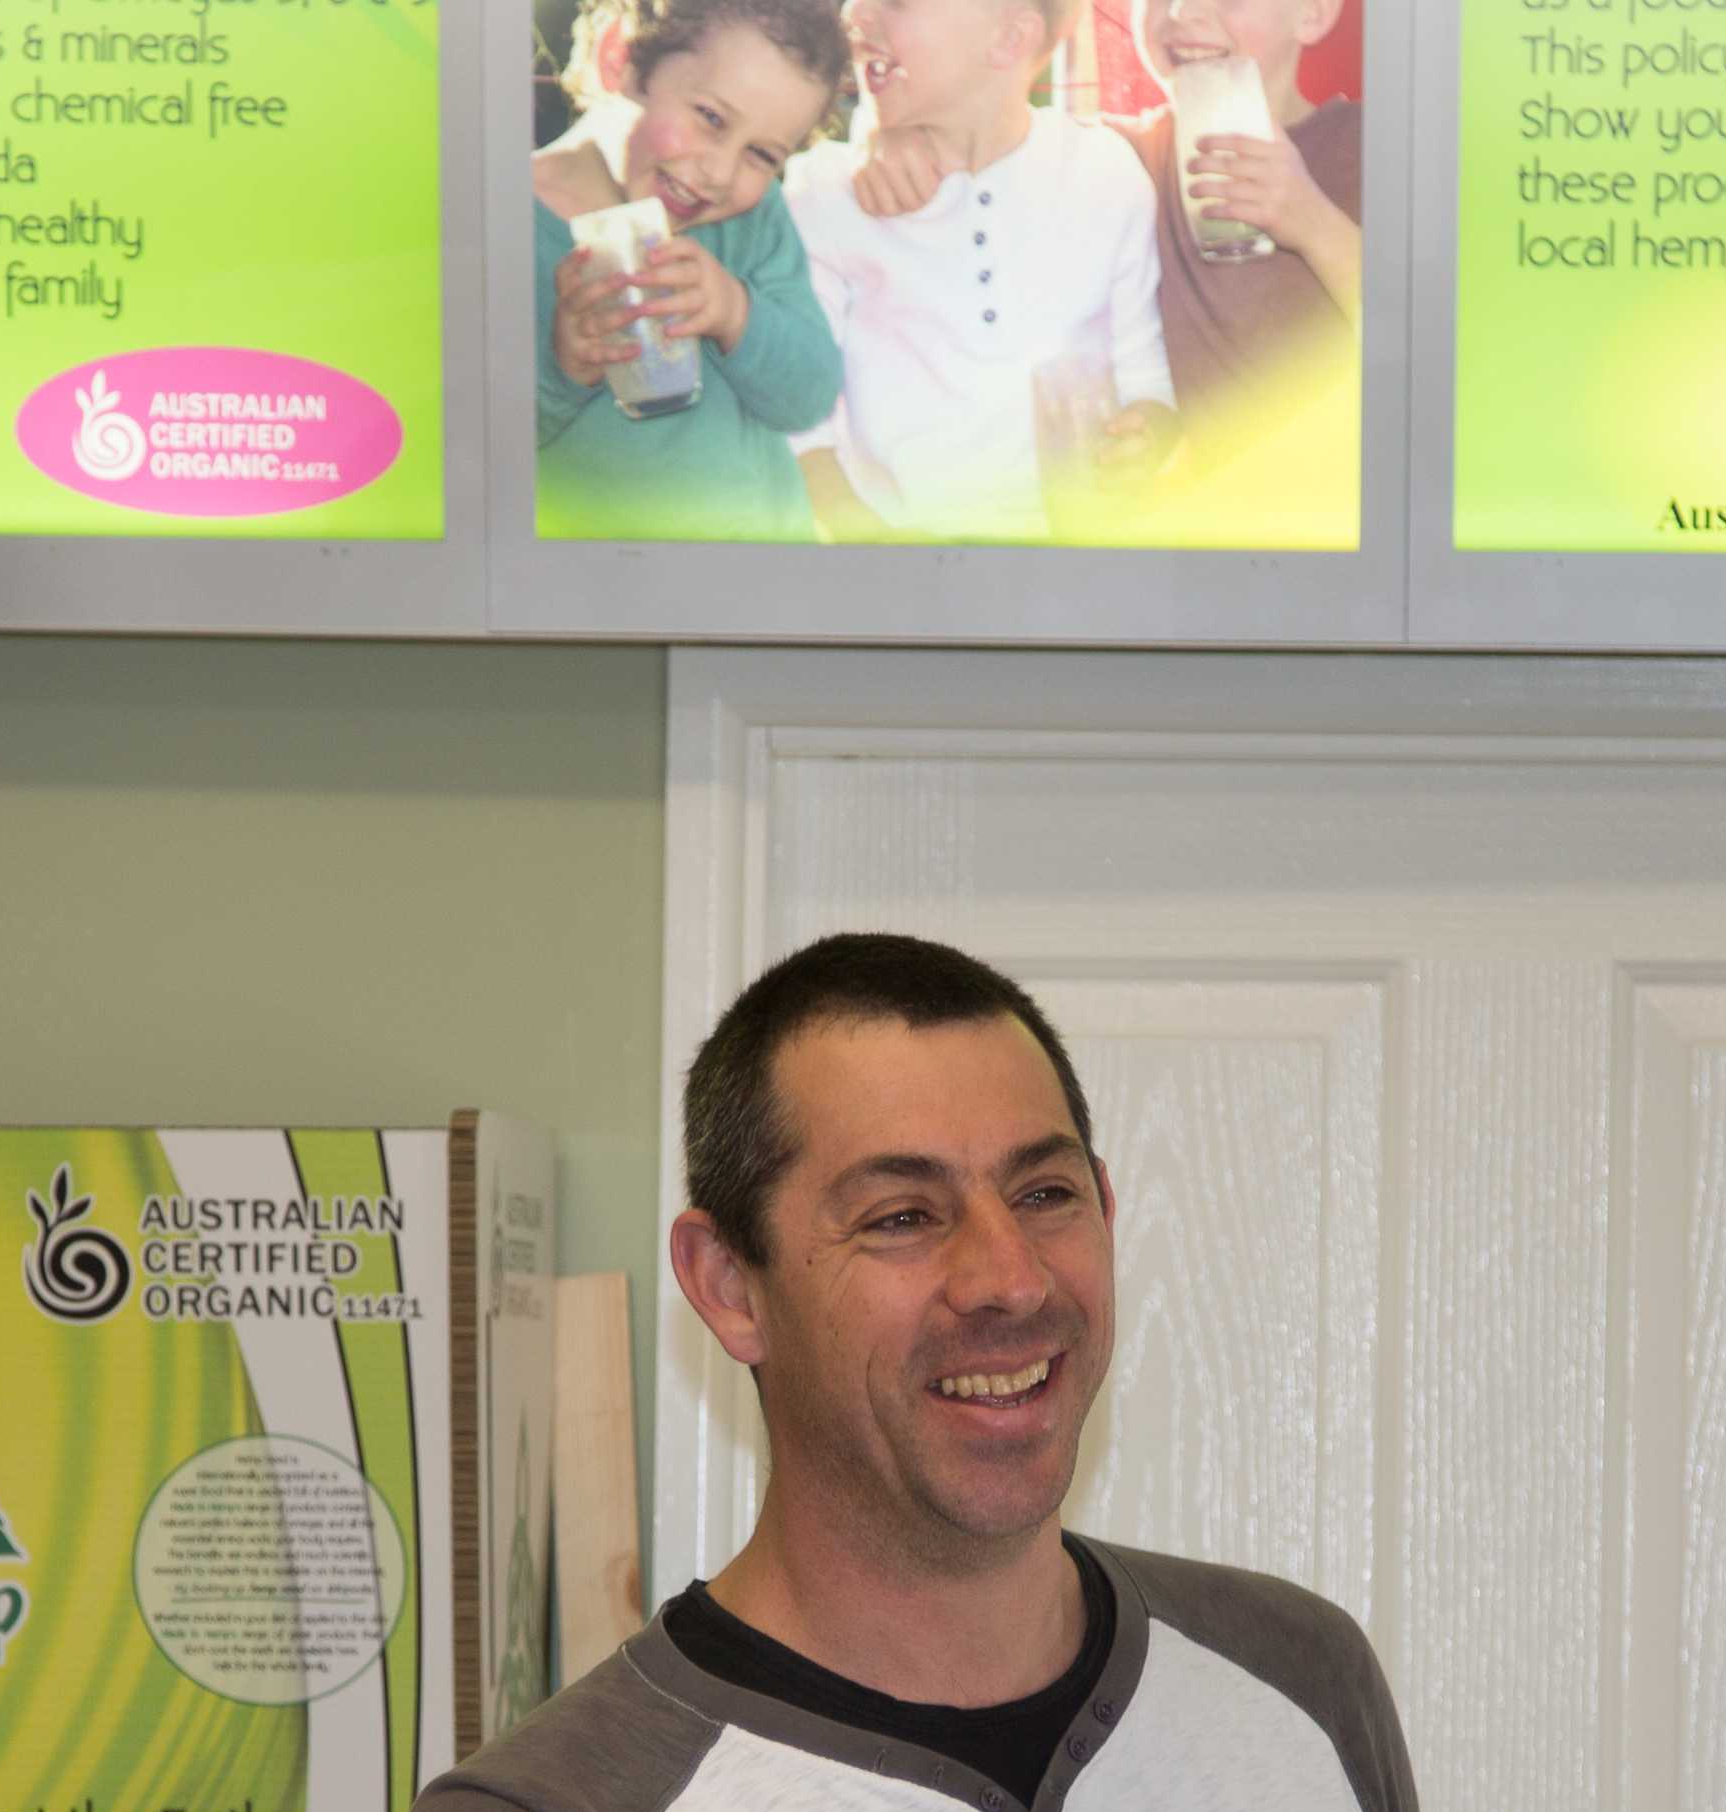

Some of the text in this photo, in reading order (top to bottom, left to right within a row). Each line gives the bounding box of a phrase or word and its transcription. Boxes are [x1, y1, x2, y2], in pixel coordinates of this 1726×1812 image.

[23, 25, 43, 61] &
[60, 21, 229, 67] minerals
[1522, 34, 1608, 76] This
[10, 82, 192, 127] chemical
[209, 83, 287, 139] free
[1518, 98, 1638, 142] Show
[1517, 160, 1635, 205] these
[1517, 223, 1616, 271] local
[3, 260, 122, 319] family
[150, 392, 327, 422] AUSTRALIAN
[150, 423, 296, 451] CERTIFIED
[150, 454, 278, 481] ORGANIC
[140, 1197, 406, 1232] AUSTRALIAN
[141, 1239, 358, 1275] CERTIFIED
[141, 1284, 423, 1320] ORGANIC 11471
